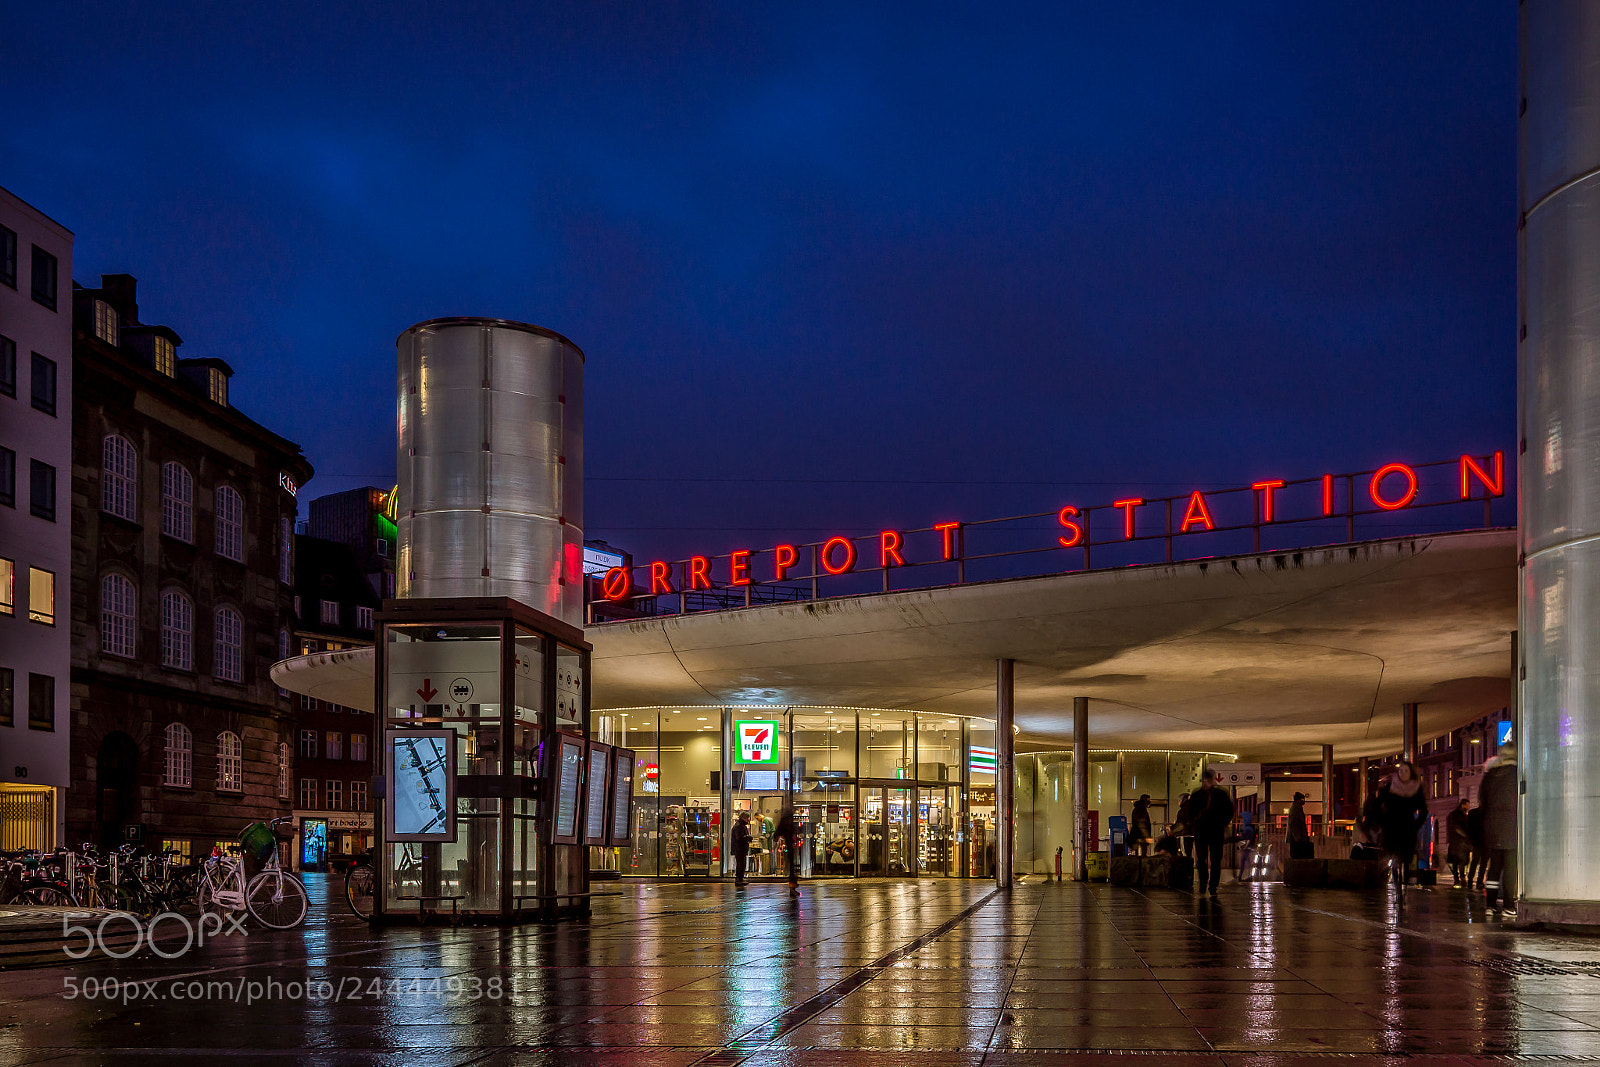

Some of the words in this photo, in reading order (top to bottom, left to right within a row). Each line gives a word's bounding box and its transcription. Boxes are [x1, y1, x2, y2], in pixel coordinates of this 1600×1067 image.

[602, 521, 961, 601] ØRREPORT
[1057, 451, 1504, 548] STATION
[745, 728, 768, 760] 7
[15, 766, 28, 778] 80
[129, 827, 137, 838] P
